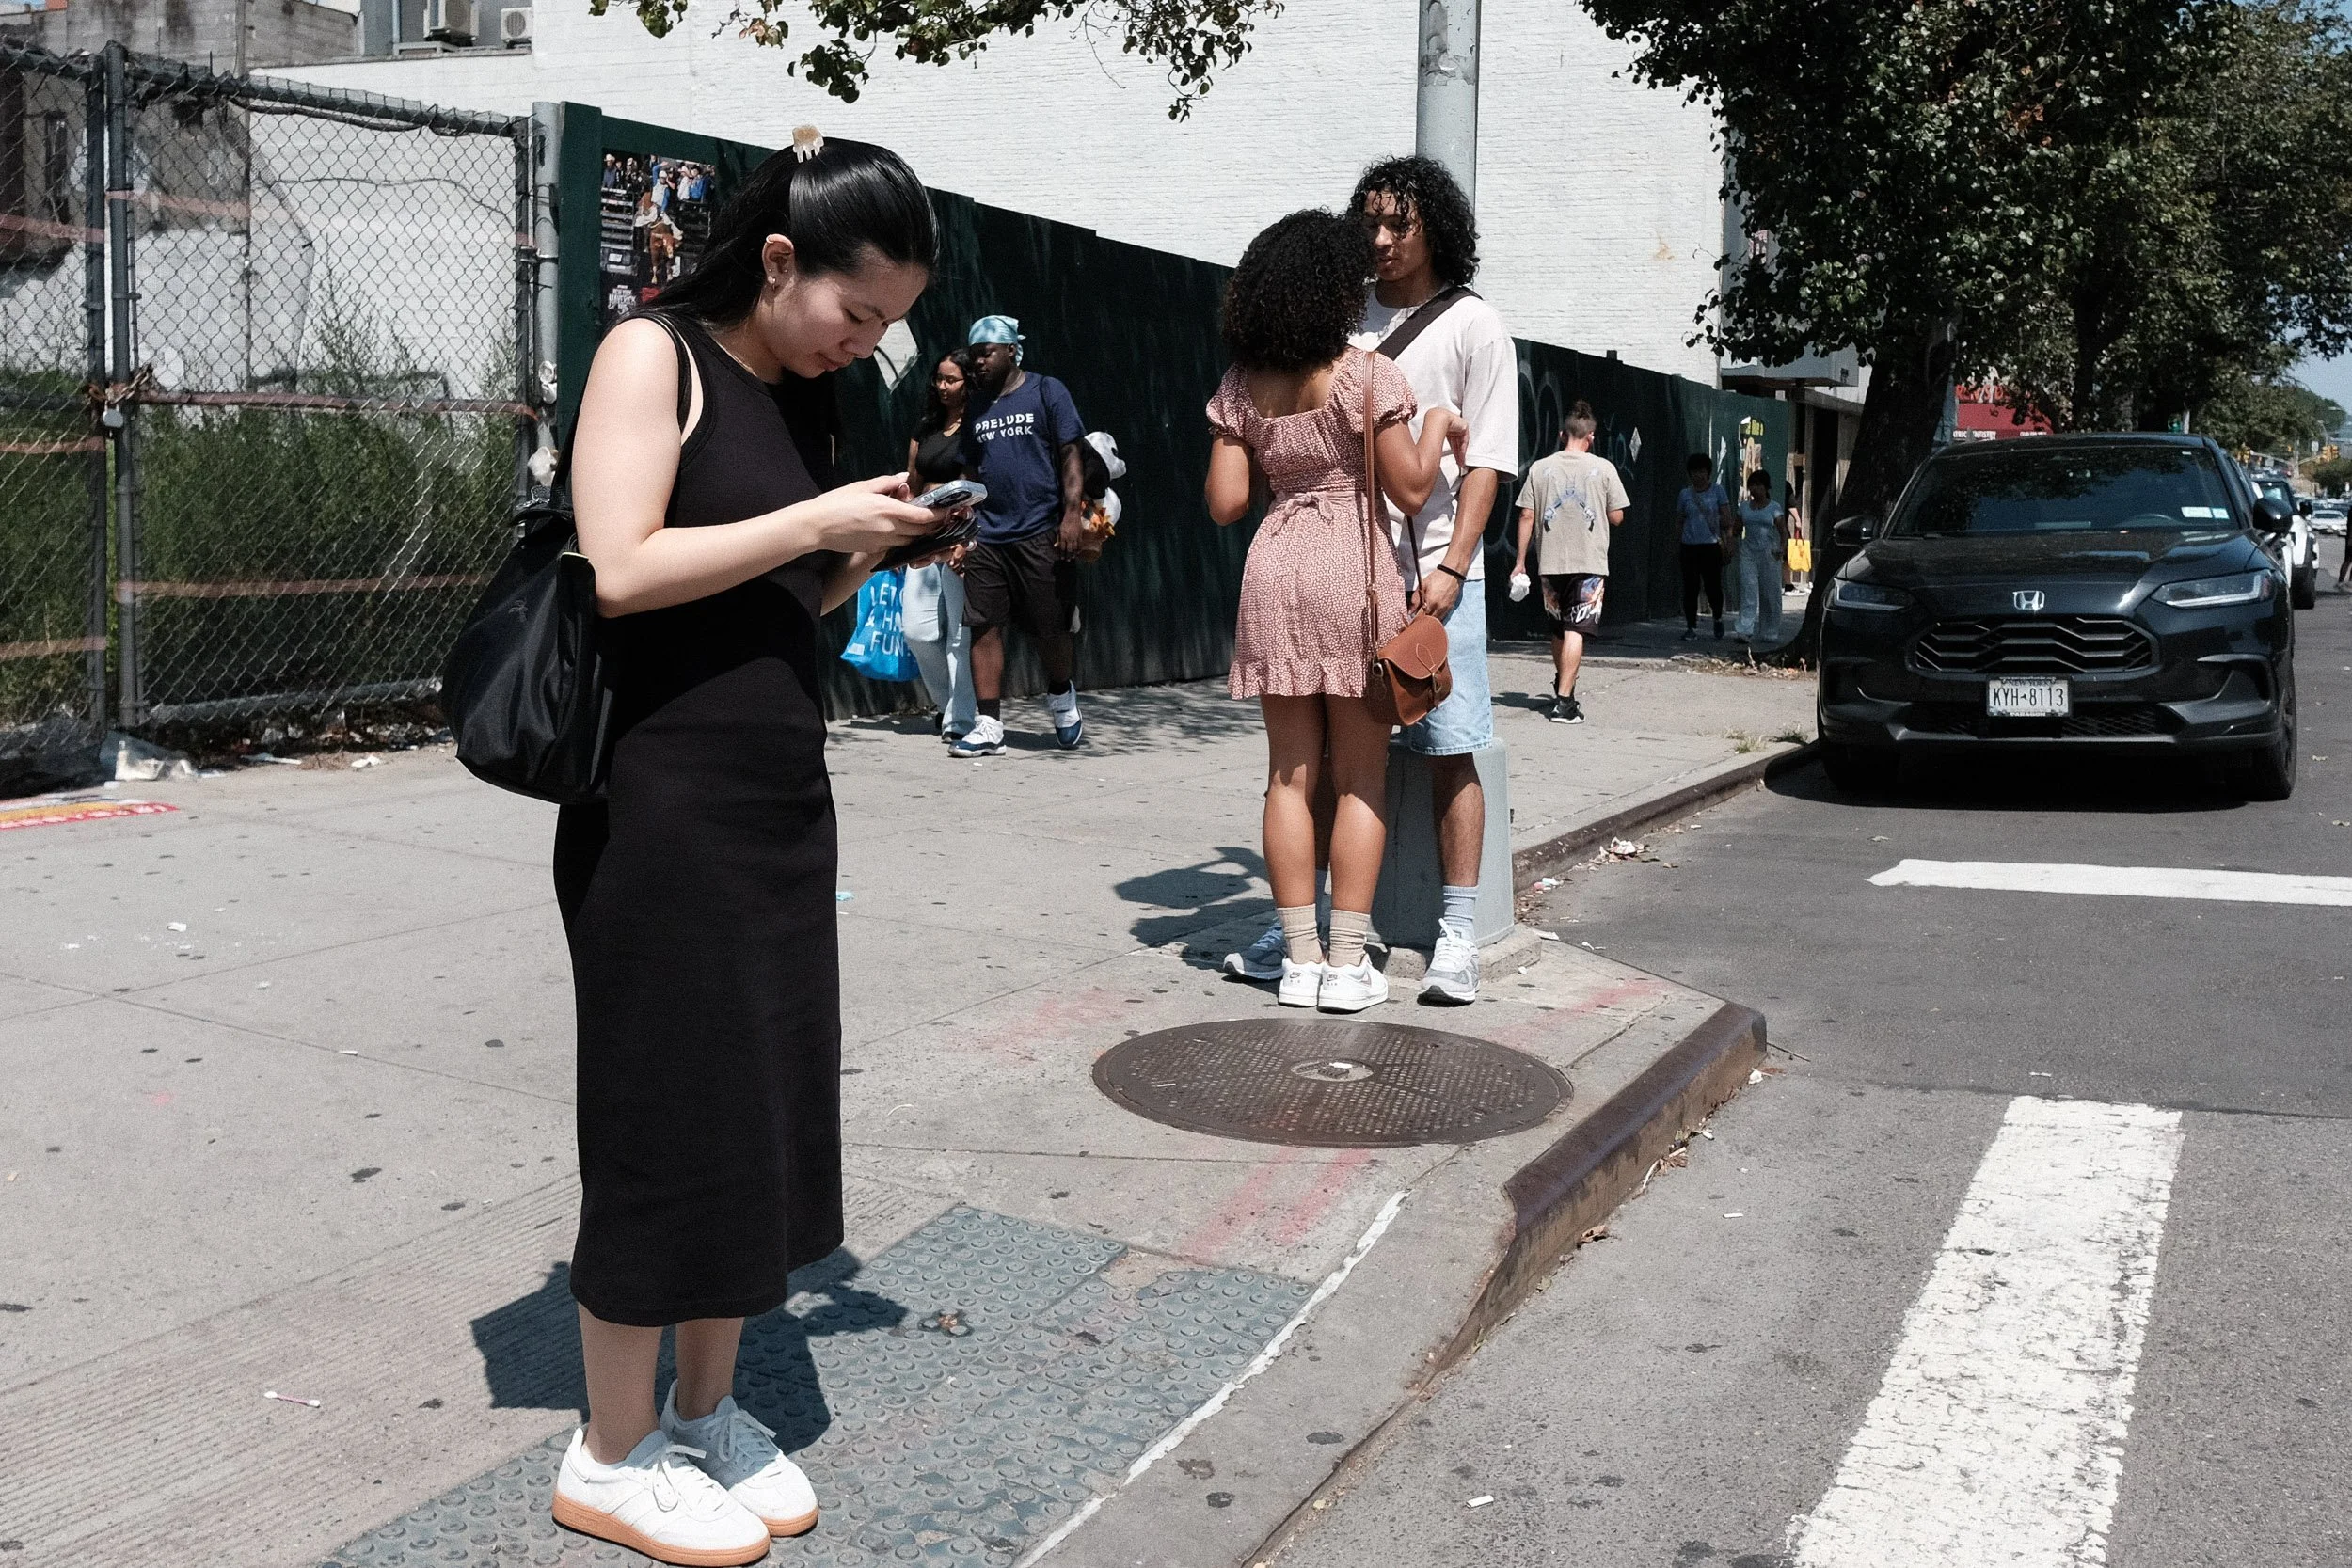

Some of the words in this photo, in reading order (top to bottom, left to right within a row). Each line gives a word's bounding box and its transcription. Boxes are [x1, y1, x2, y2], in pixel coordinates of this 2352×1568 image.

[975, 413, 1034, 434] PRELUDE
[976, 431, 996, 443] NEW
[1000, 425, 1033, 438] YORK
